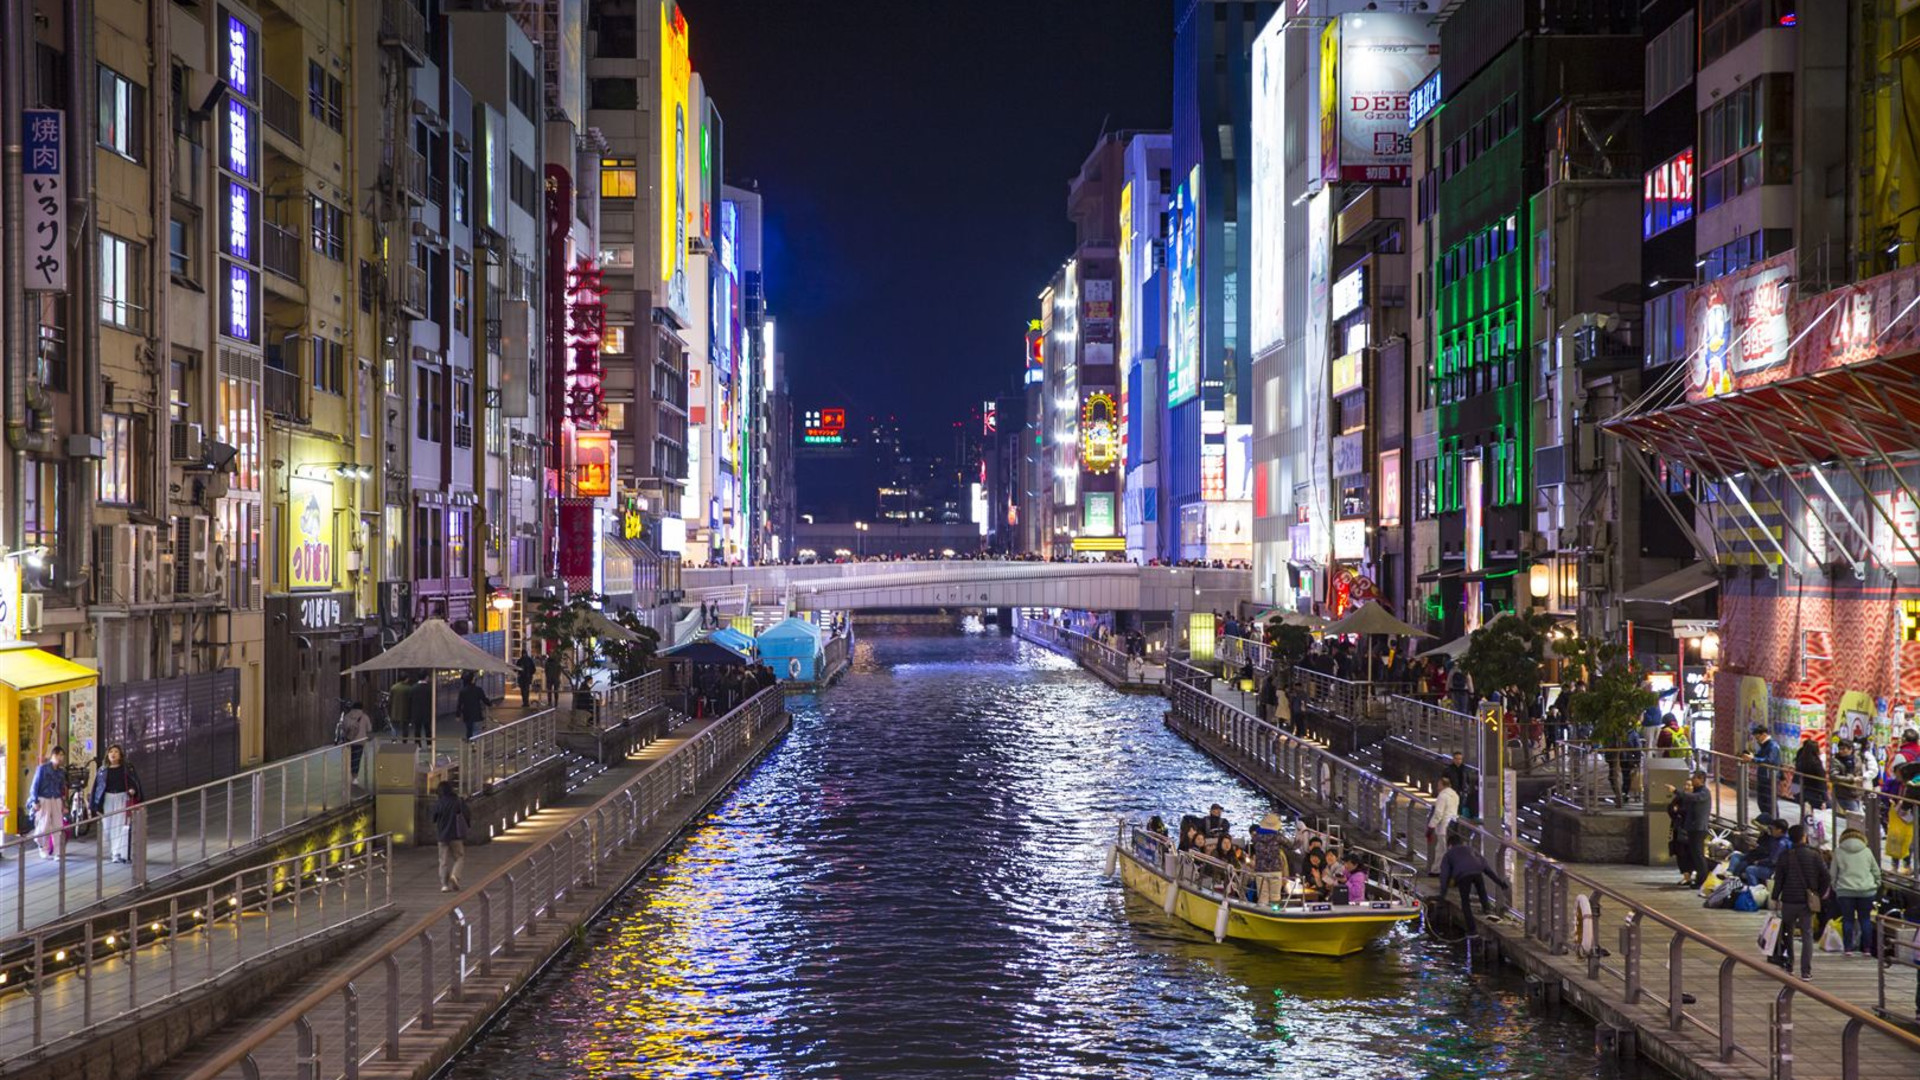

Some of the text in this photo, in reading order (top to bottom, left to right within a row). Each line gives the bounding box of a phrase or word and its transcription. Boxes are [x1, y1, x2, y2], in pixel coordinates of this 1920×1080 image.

[1351, 97, 1409, 111] DEE
[1364, 112, 1410, 121] Grou
[32, 117, 59, 170] 焼肉
[33, 178, 60, 285] いろりや
